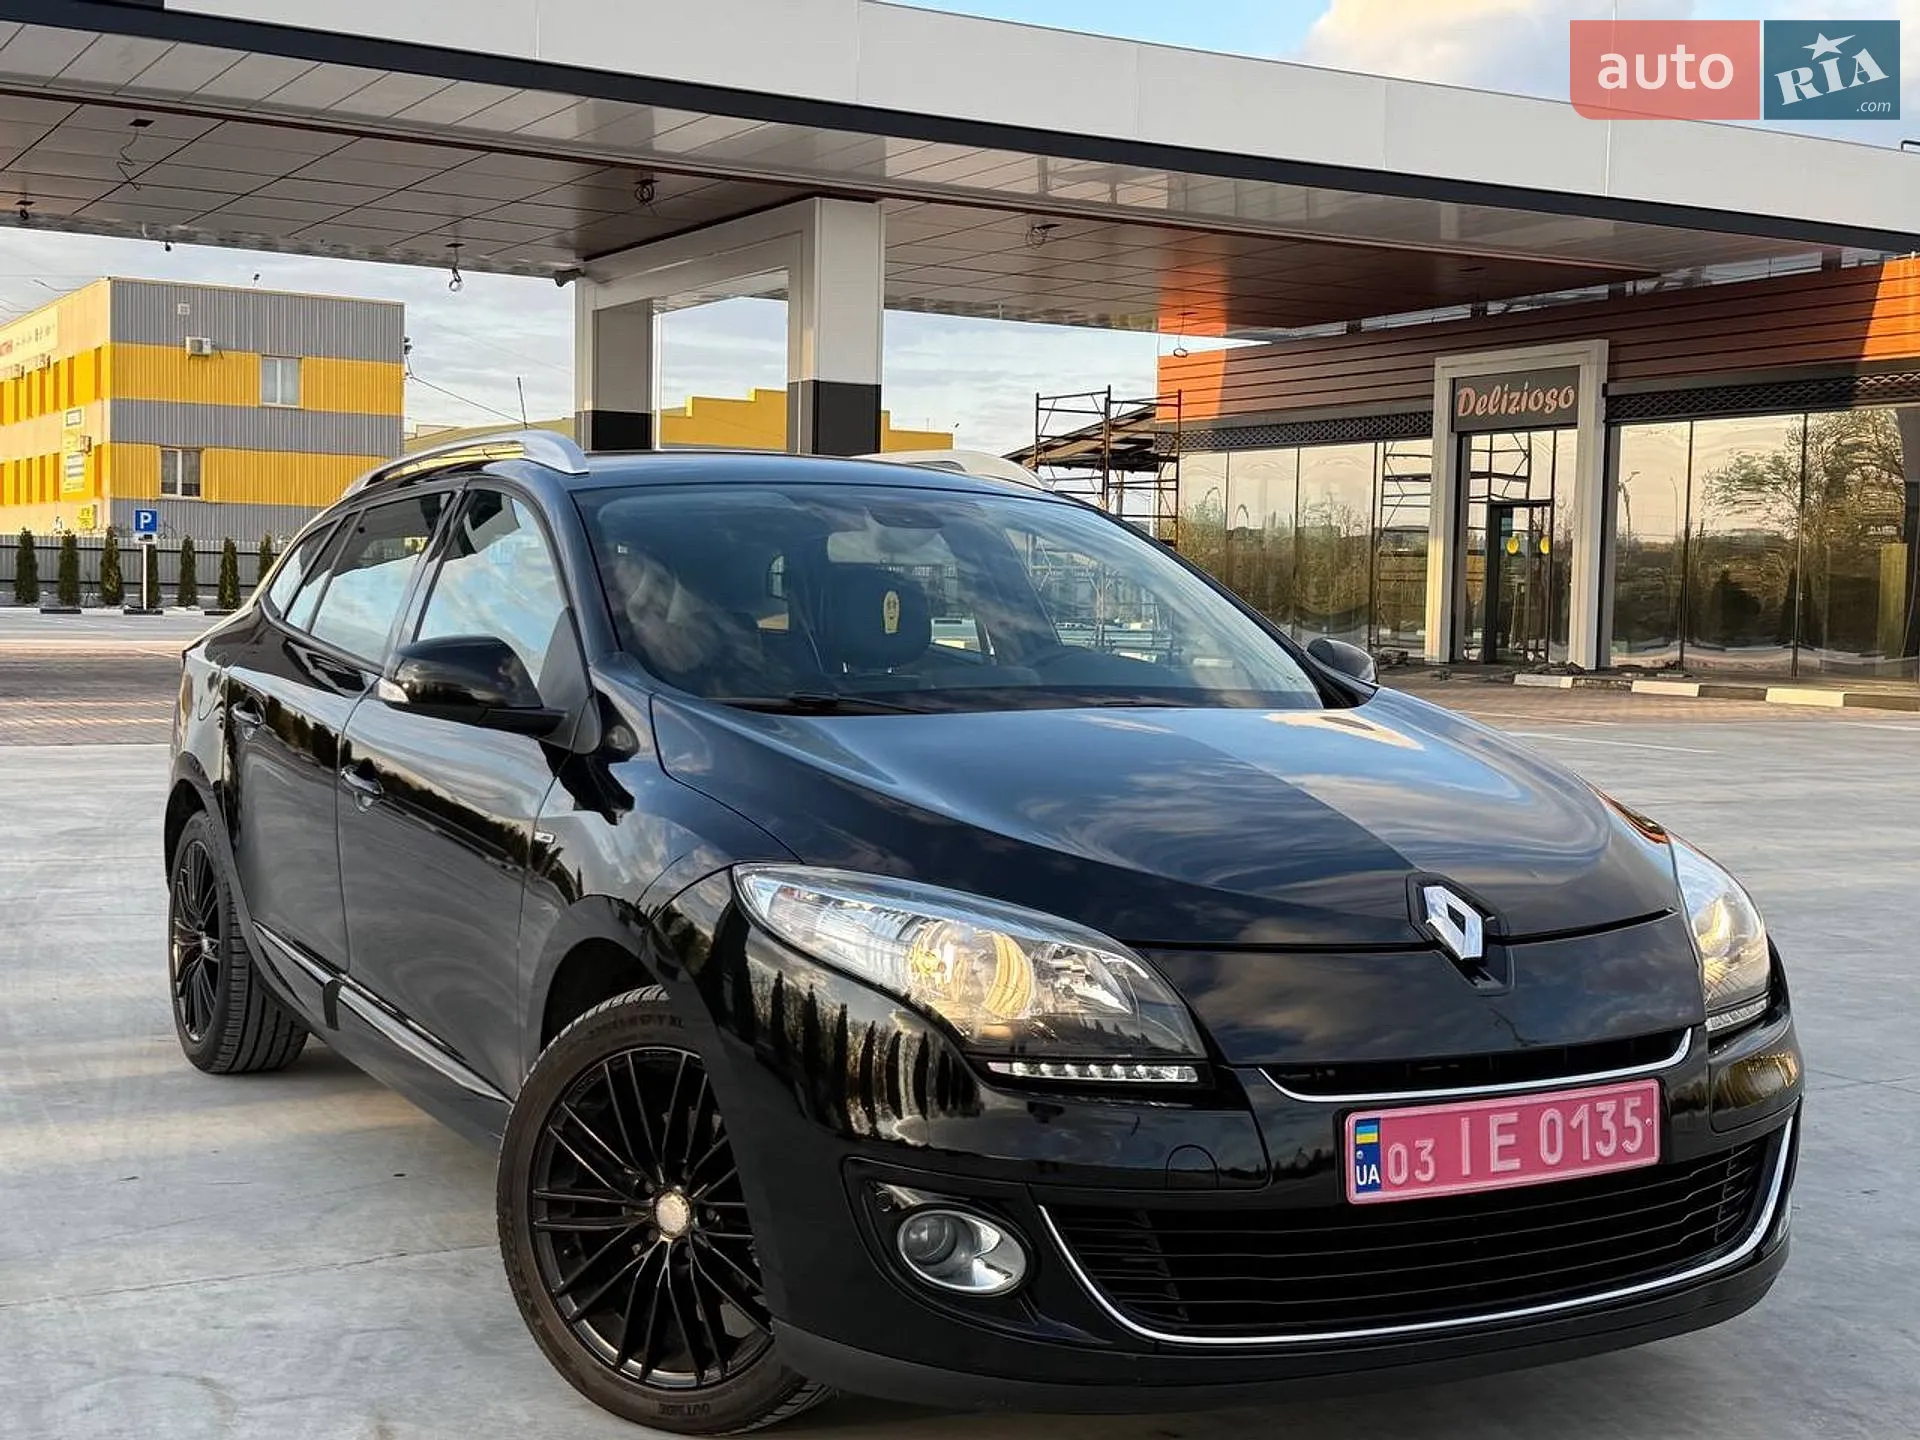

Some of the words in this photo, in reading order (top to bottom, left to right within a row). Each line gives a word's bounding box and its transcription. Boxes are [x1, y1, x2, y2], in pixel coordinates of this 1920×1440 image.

[1457, 380, 1575, 417] Delizioso
[140, 511, 152, 529] P
[1387, 1138, 1436, 1185] 03
[1461, 1112, 1521, 1177] IE
[1539, 1096, 1644, 1166] 0135
[1355, 1164, 1381, 1186] UA
